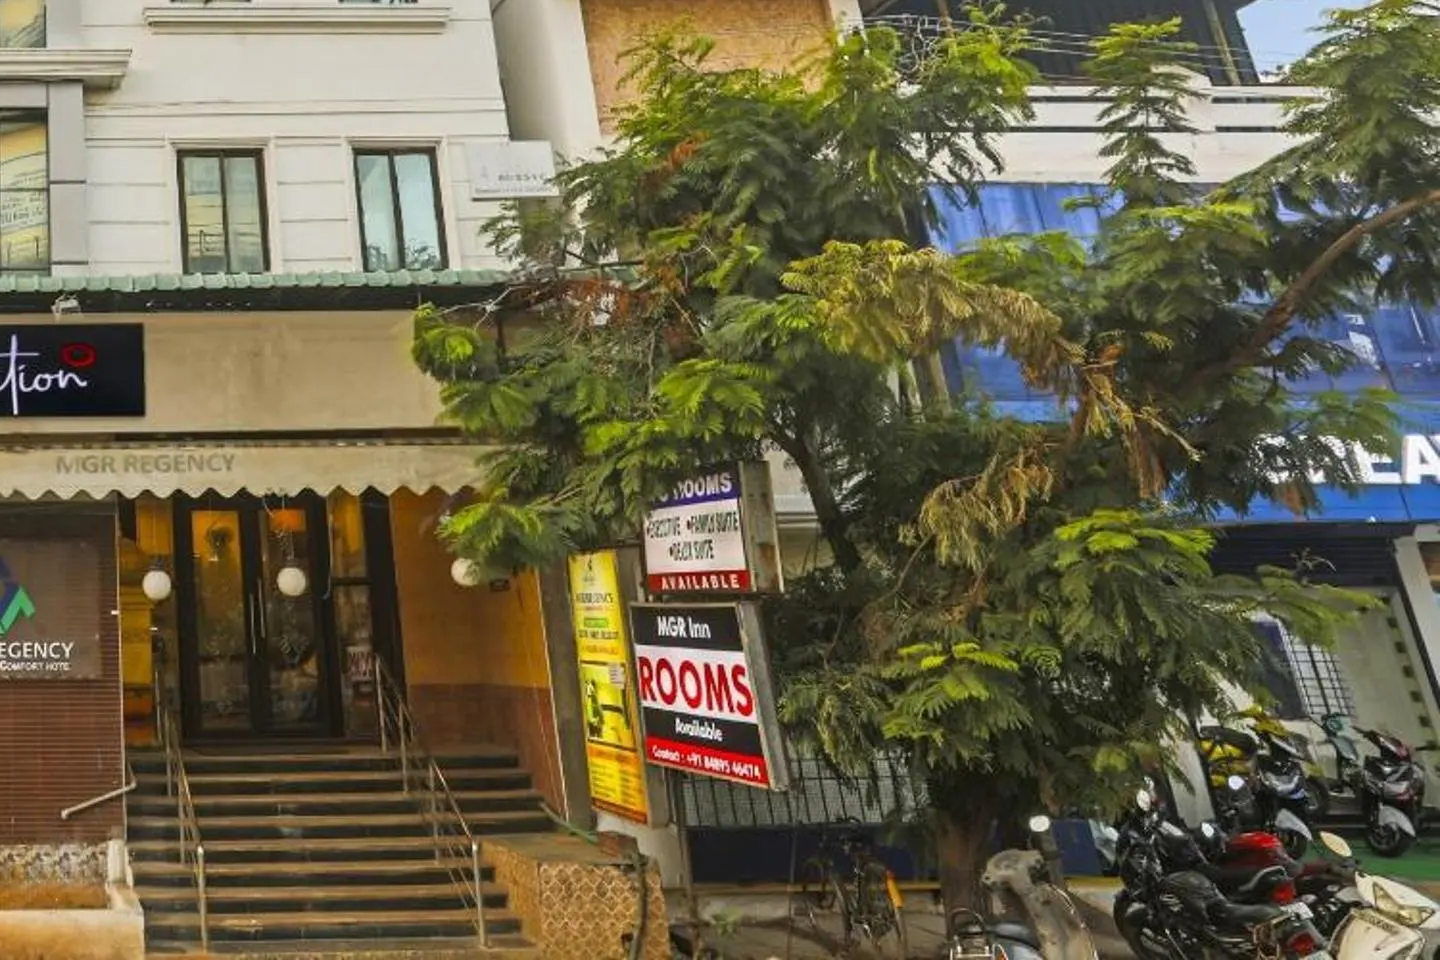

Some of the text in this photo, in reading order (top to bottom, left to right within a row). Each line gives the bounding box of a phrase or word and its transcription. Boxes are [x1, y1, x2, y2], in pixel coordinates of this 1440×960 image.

[56, 453, 236, 474] MGR REGENCY
[662, 573, 740, 590] AVAILABLE
[657, 615, 711, 639] MGR Inn
[638, 656, 753, 717] ROOMS
[675, 717, 723, 742] Available
